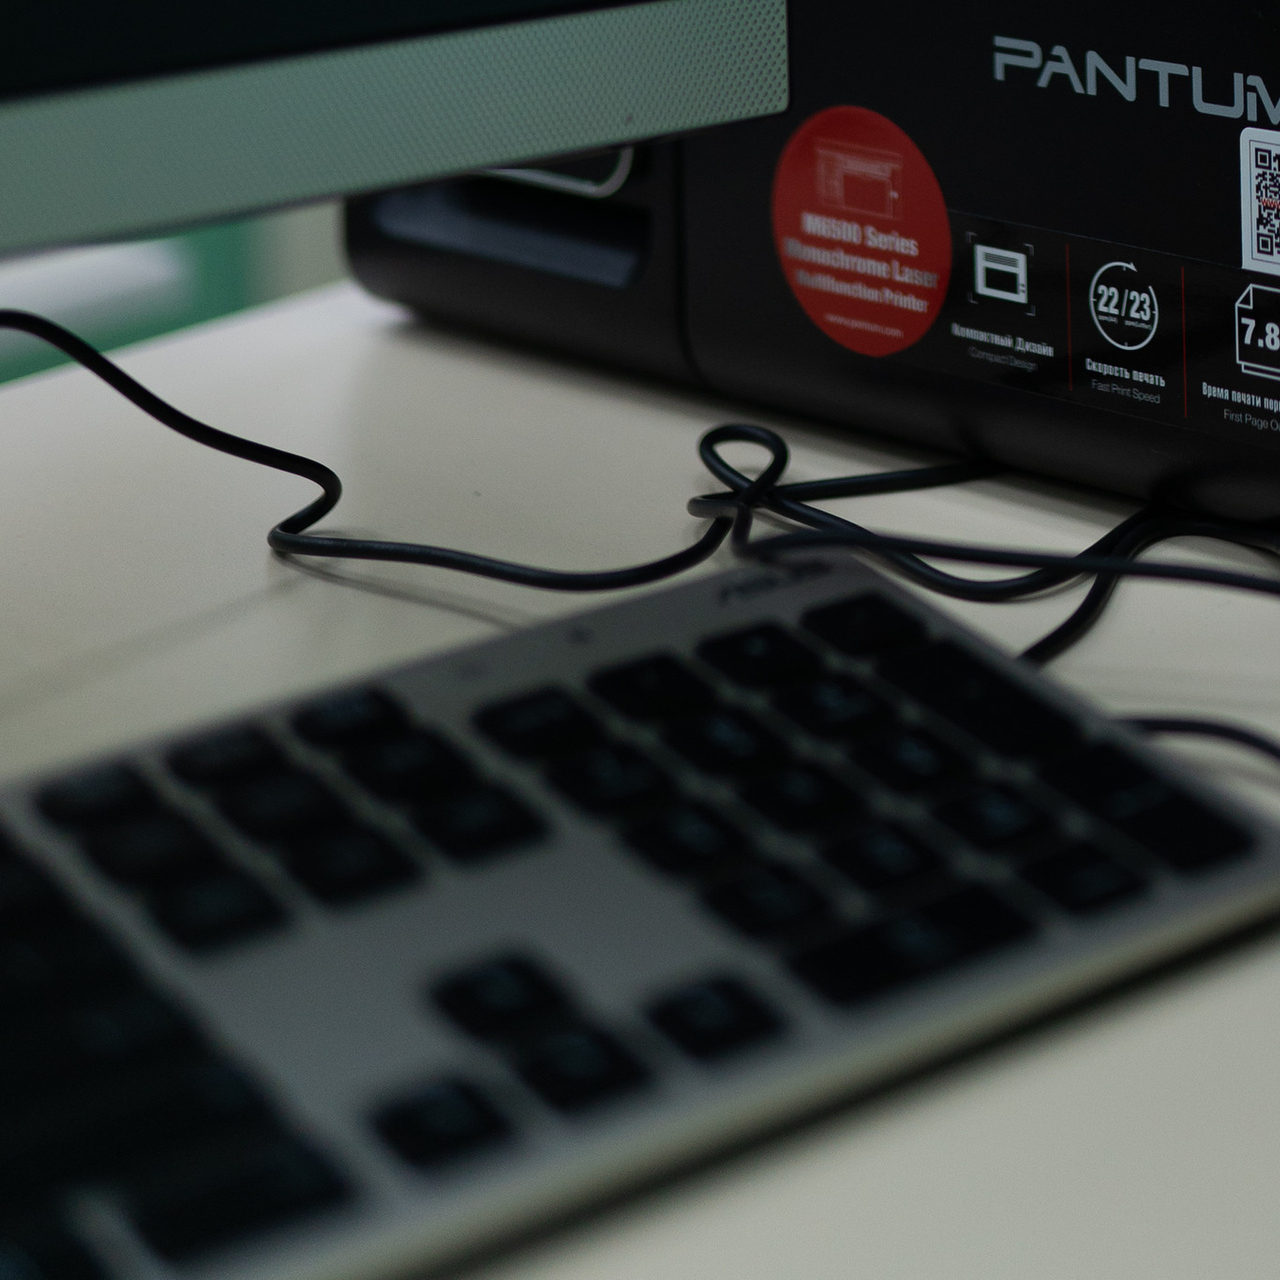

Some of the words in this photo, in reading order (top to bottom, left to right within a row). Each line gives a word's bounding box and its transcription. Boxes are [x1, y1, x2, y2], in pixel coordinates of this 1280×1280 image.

[862, 224, 919, 257] Series
[783, 237, 889, 279] Monochrome
[890, 259, 940, 290] Laser
[794, 268, 881, 303] Multifunction
[881, 285, 930, 313] Printer
[951, 322, 1014, 348] Компактный
[1014, 337, 1055, 358] Дизайн
[1085, 357, 1130, 380] Скорость
[1131, 370, 1166, 387] печать
[1091, 378, 1111, 392] Fast
[1110, 383, 1132, 397] Print
[1132, 388, 1161, 405] Speed
[1202, 381, 1230, 401] Время
[1231, 390, 1261, 409] печати
[1223, 408, 1243, 424] First
[1244, 413, 1269, 431] Page
